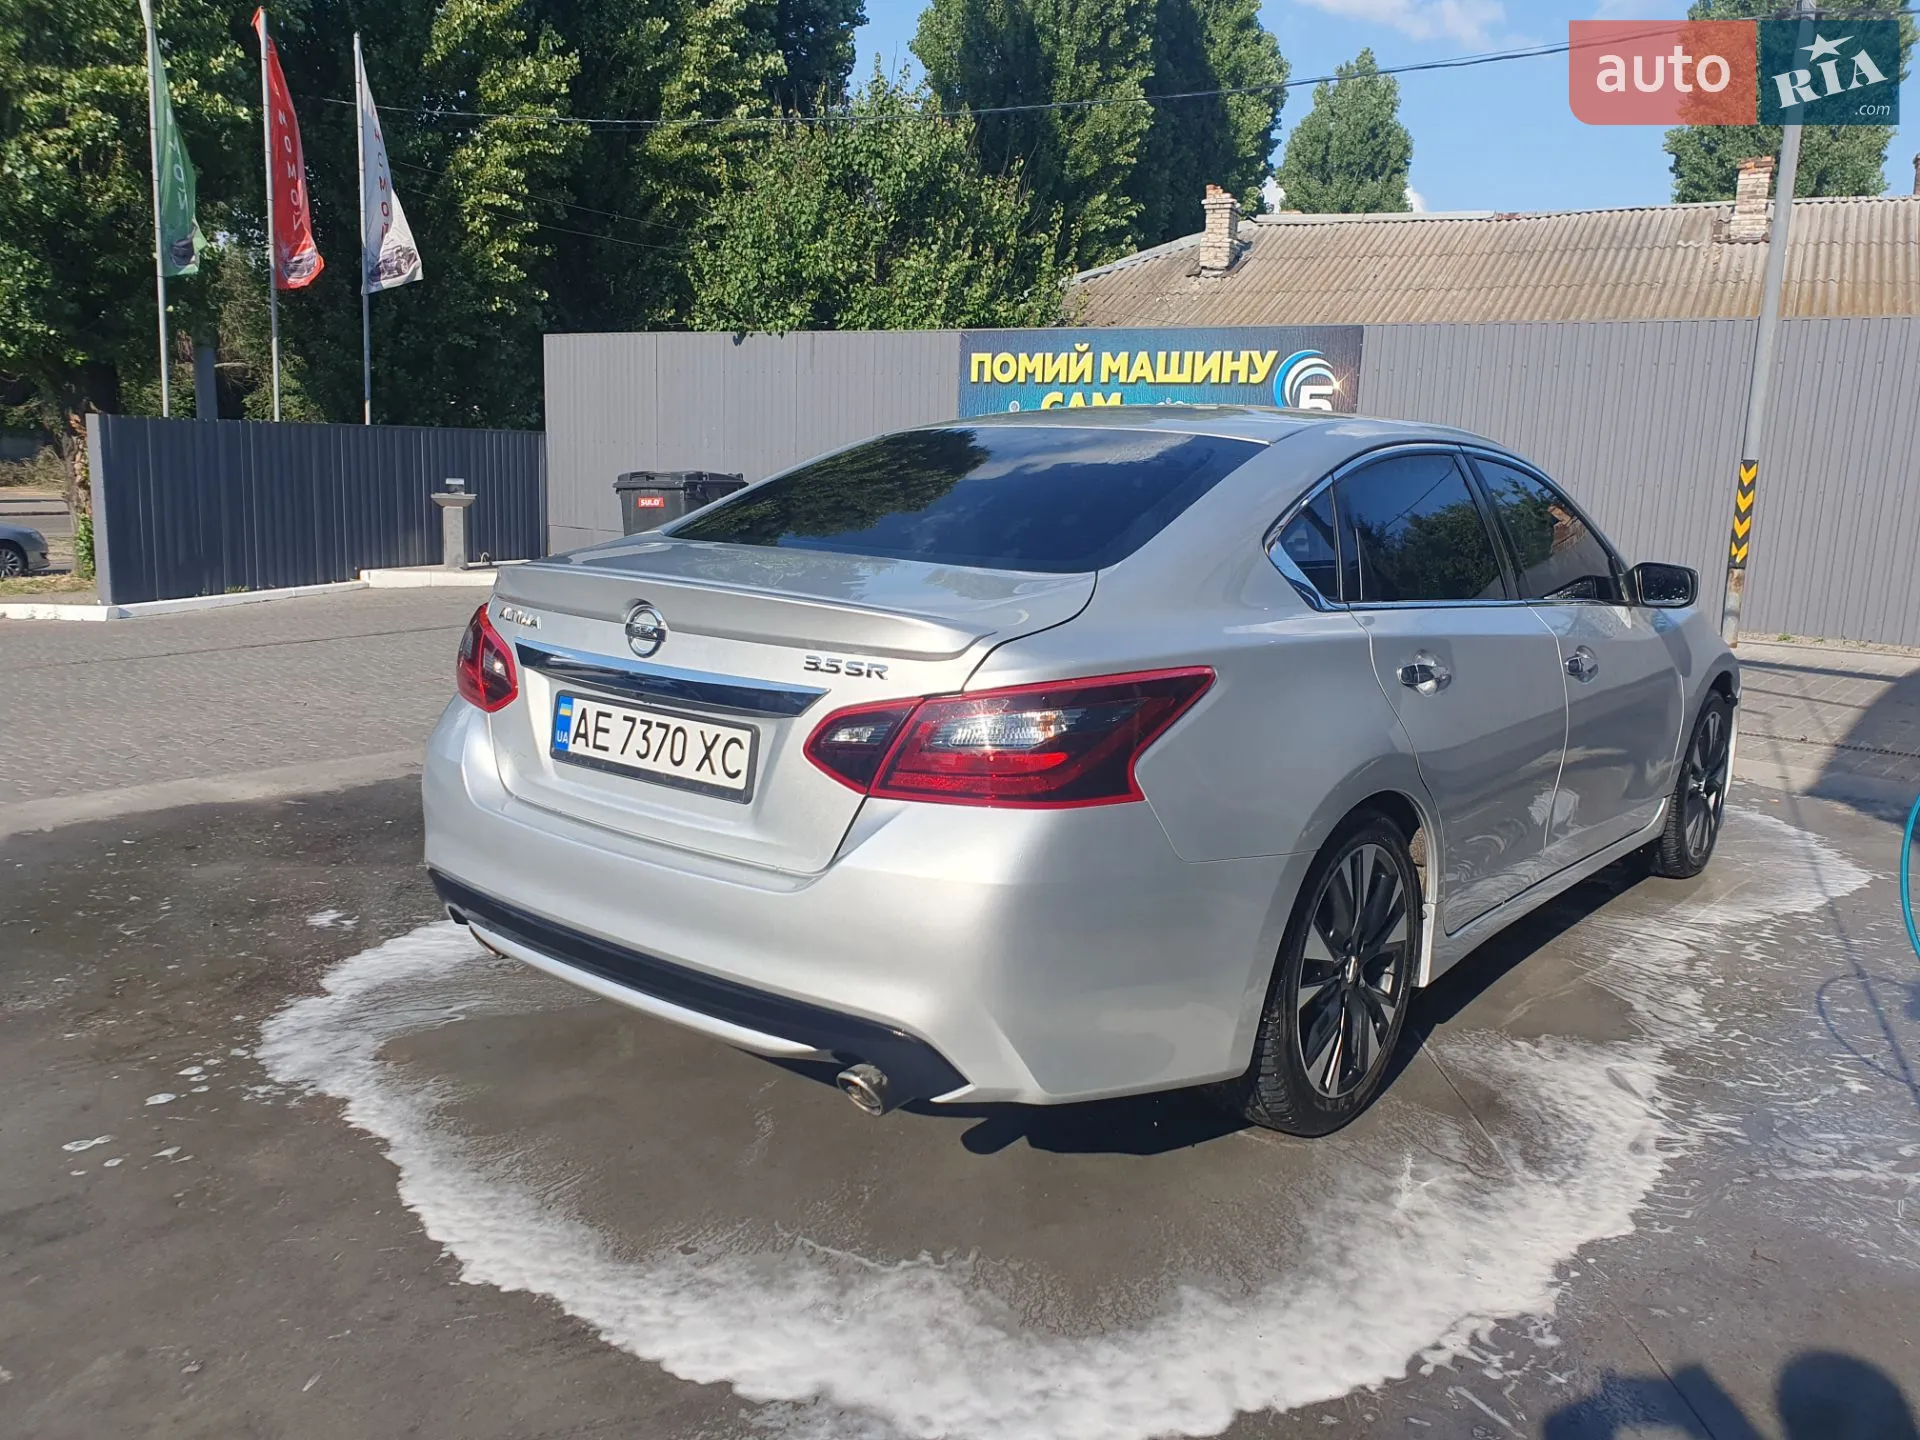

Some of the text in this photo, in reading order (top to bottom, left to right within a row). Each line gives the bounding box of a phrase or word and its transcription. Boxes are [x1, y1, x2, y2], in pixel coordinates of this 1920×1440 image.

[970, 343, 1279, 384] ПОМИЙ МАШИНУ
[556, 730, 568, 744] UA
[571, 707, 746, 780] AE 7370 XC
